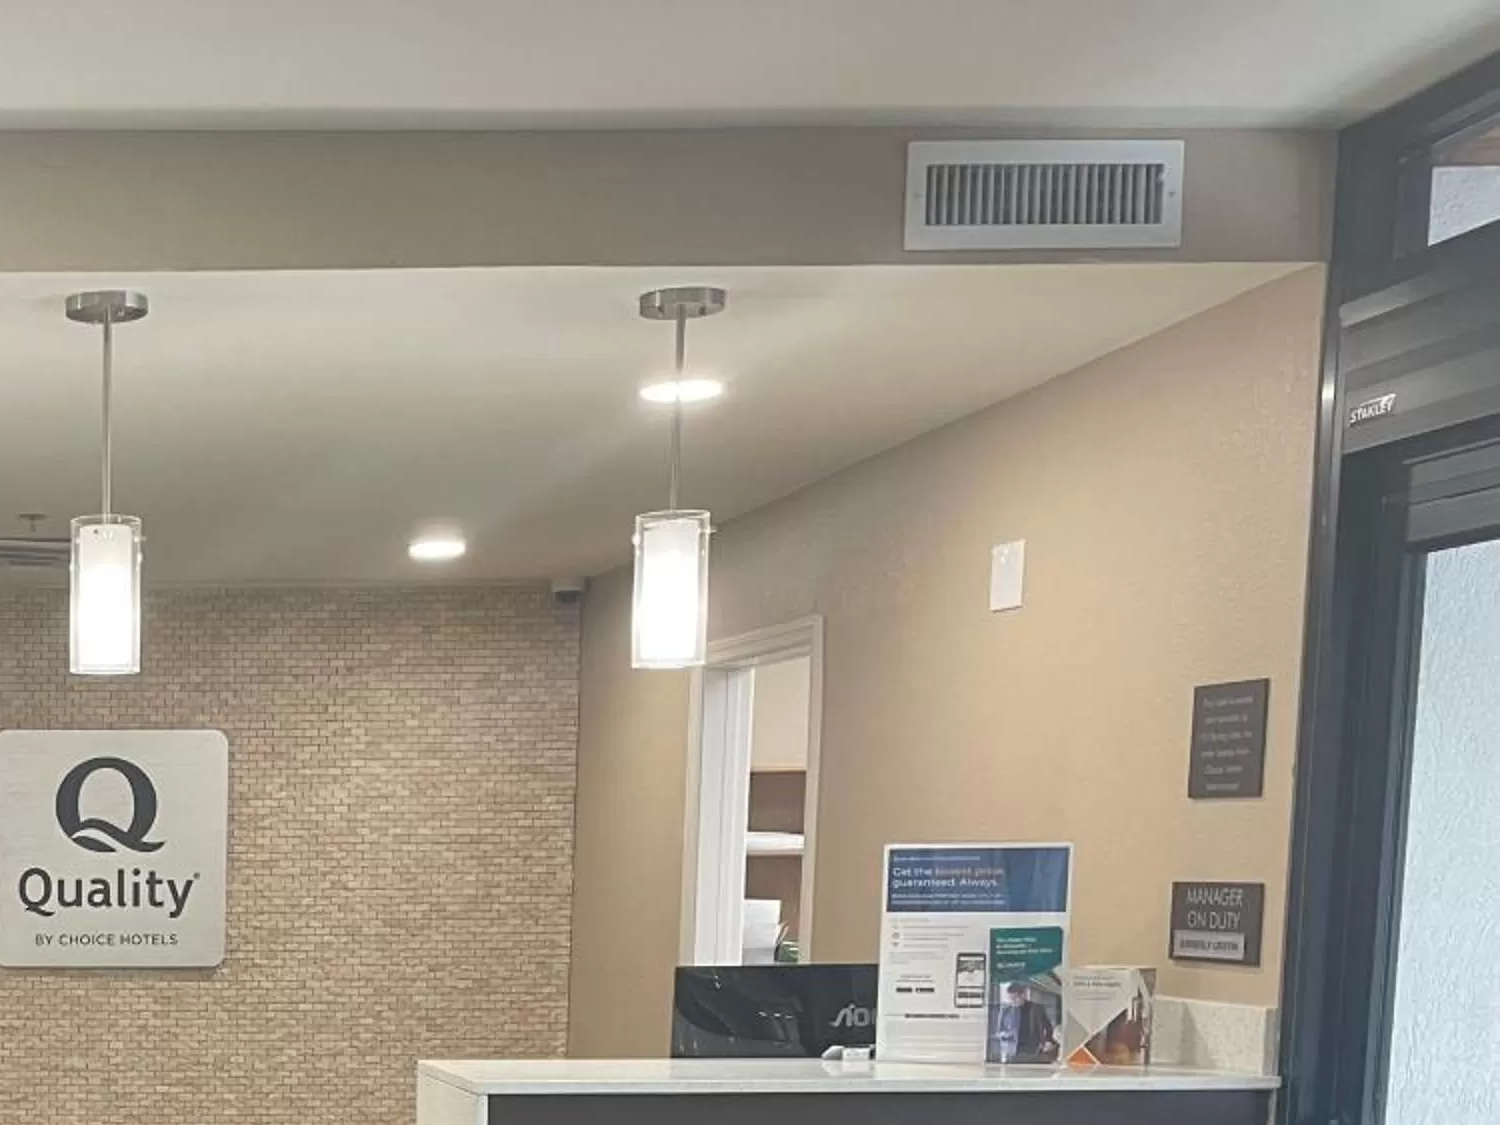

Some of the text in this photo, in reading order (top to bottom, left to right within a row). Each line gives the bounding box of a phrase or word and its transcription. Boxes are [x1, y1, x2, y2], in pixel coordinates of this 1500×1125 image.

[55, 756, 166, 853] Q
[18, 867, 195, 919] Quality
[1187, 887, 1244, 907] MANAGER
[1187, 909, 1241, 929] ON DUTY
[35, 933, 179, 946] BY CHOICE HOTELS
